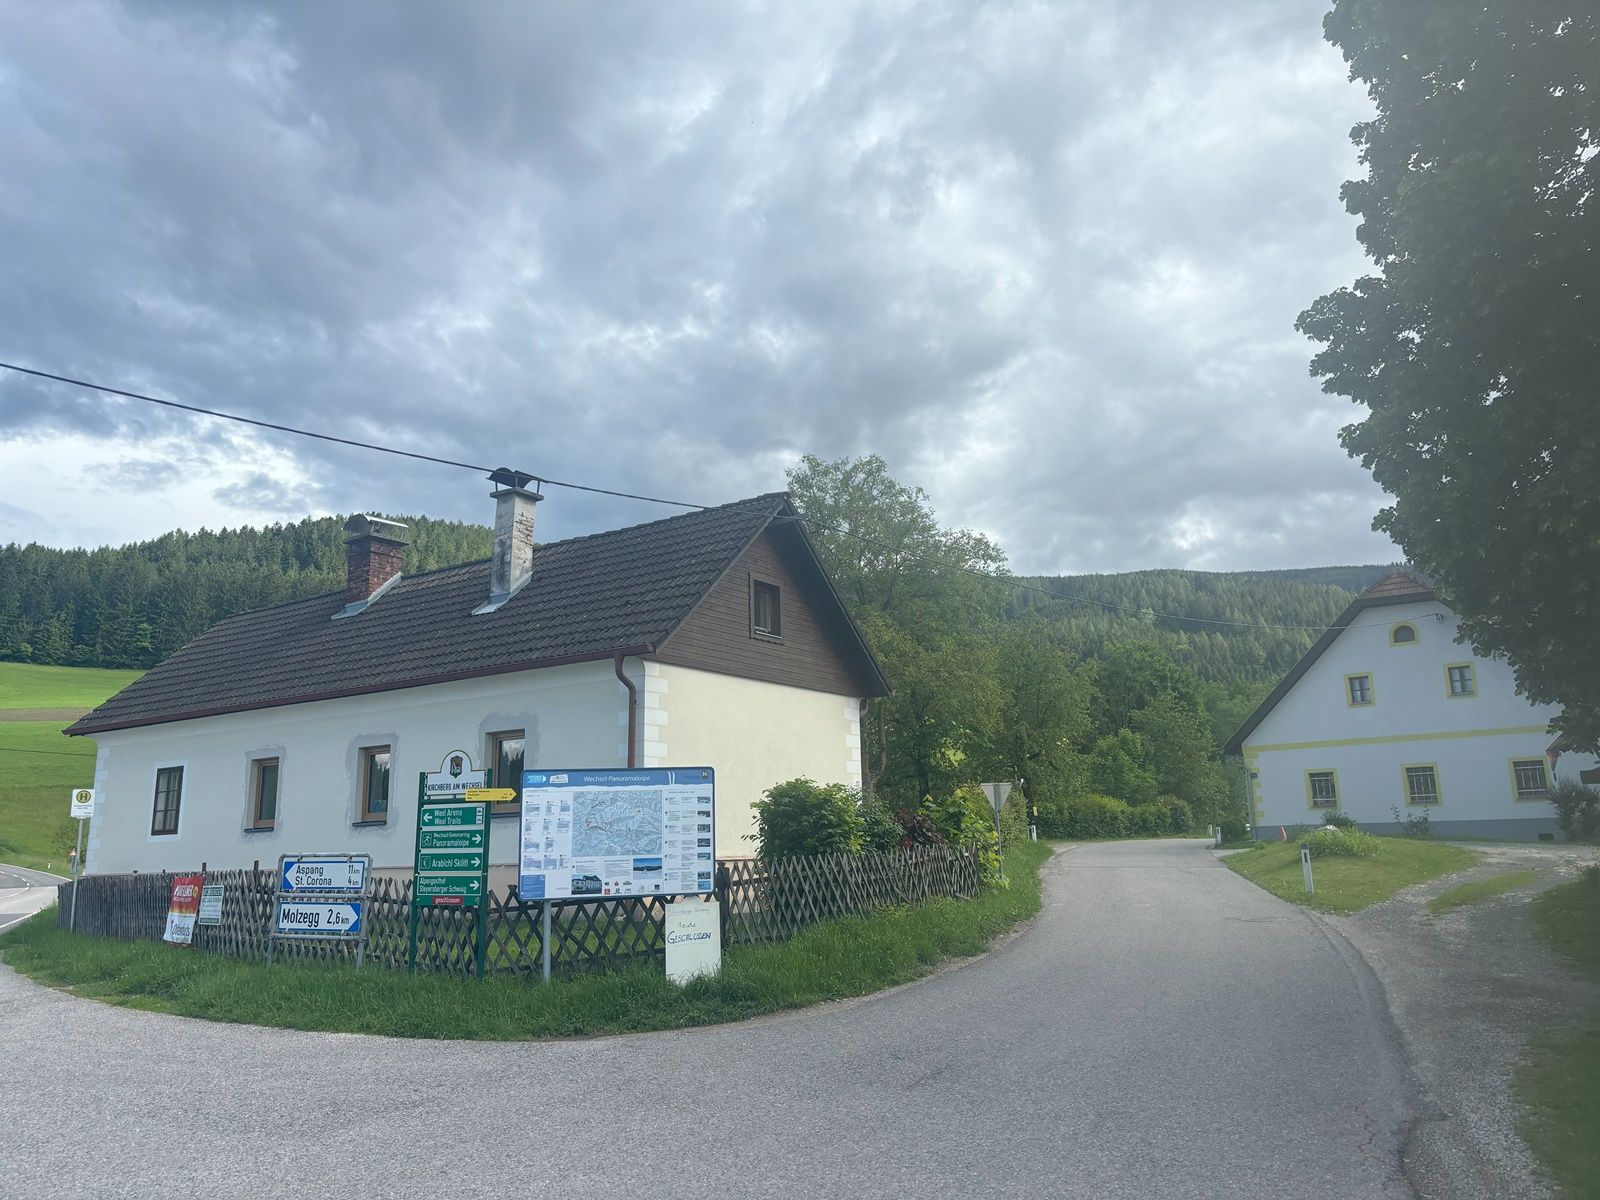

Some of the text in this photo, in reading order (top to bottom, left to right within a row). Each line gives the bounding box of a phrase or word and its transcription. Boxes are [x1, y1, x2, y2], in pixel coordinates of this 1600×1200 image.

[583, 775, 651, 783] Wechsel-Panoramaloipe
[427, 781, 483, 792] KIRCHBERG AM WECHSEL
[447, 817, 461, 825] Trails
[432, 838, 469, 848] Panoramaloipe
[296, 865, 324, 876] Aspang
[348, 864, 354, 875] 11
[295, 876, 332, 886] St. Corona
[281, 908, 350, 928] Molzegg 2,6 km
